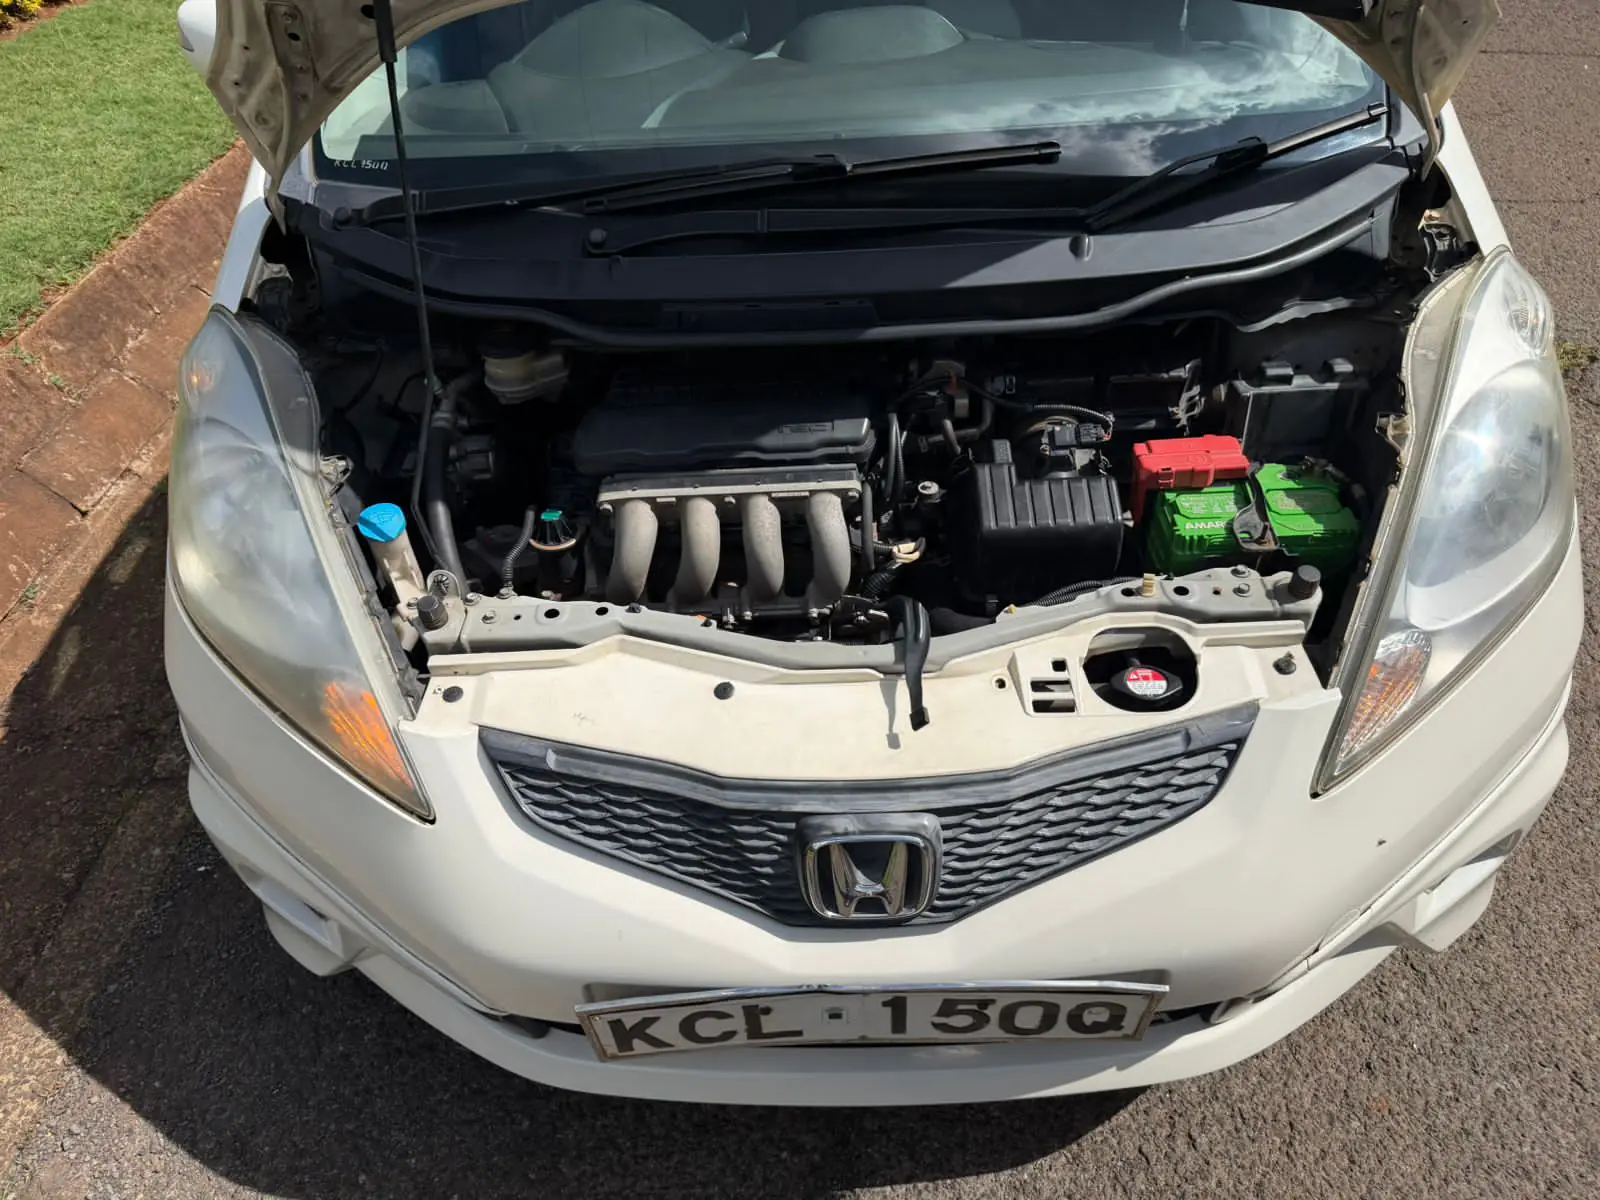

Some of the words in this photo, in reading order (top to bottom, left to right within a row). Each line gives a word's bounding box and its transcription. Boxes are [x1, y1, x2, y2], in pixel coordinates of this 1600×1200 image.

[1185, 521, 1230, 529] AMAR
[607, 1004, 804, 1053] KCL
[881, 996, 1125, 1036] 150Q
